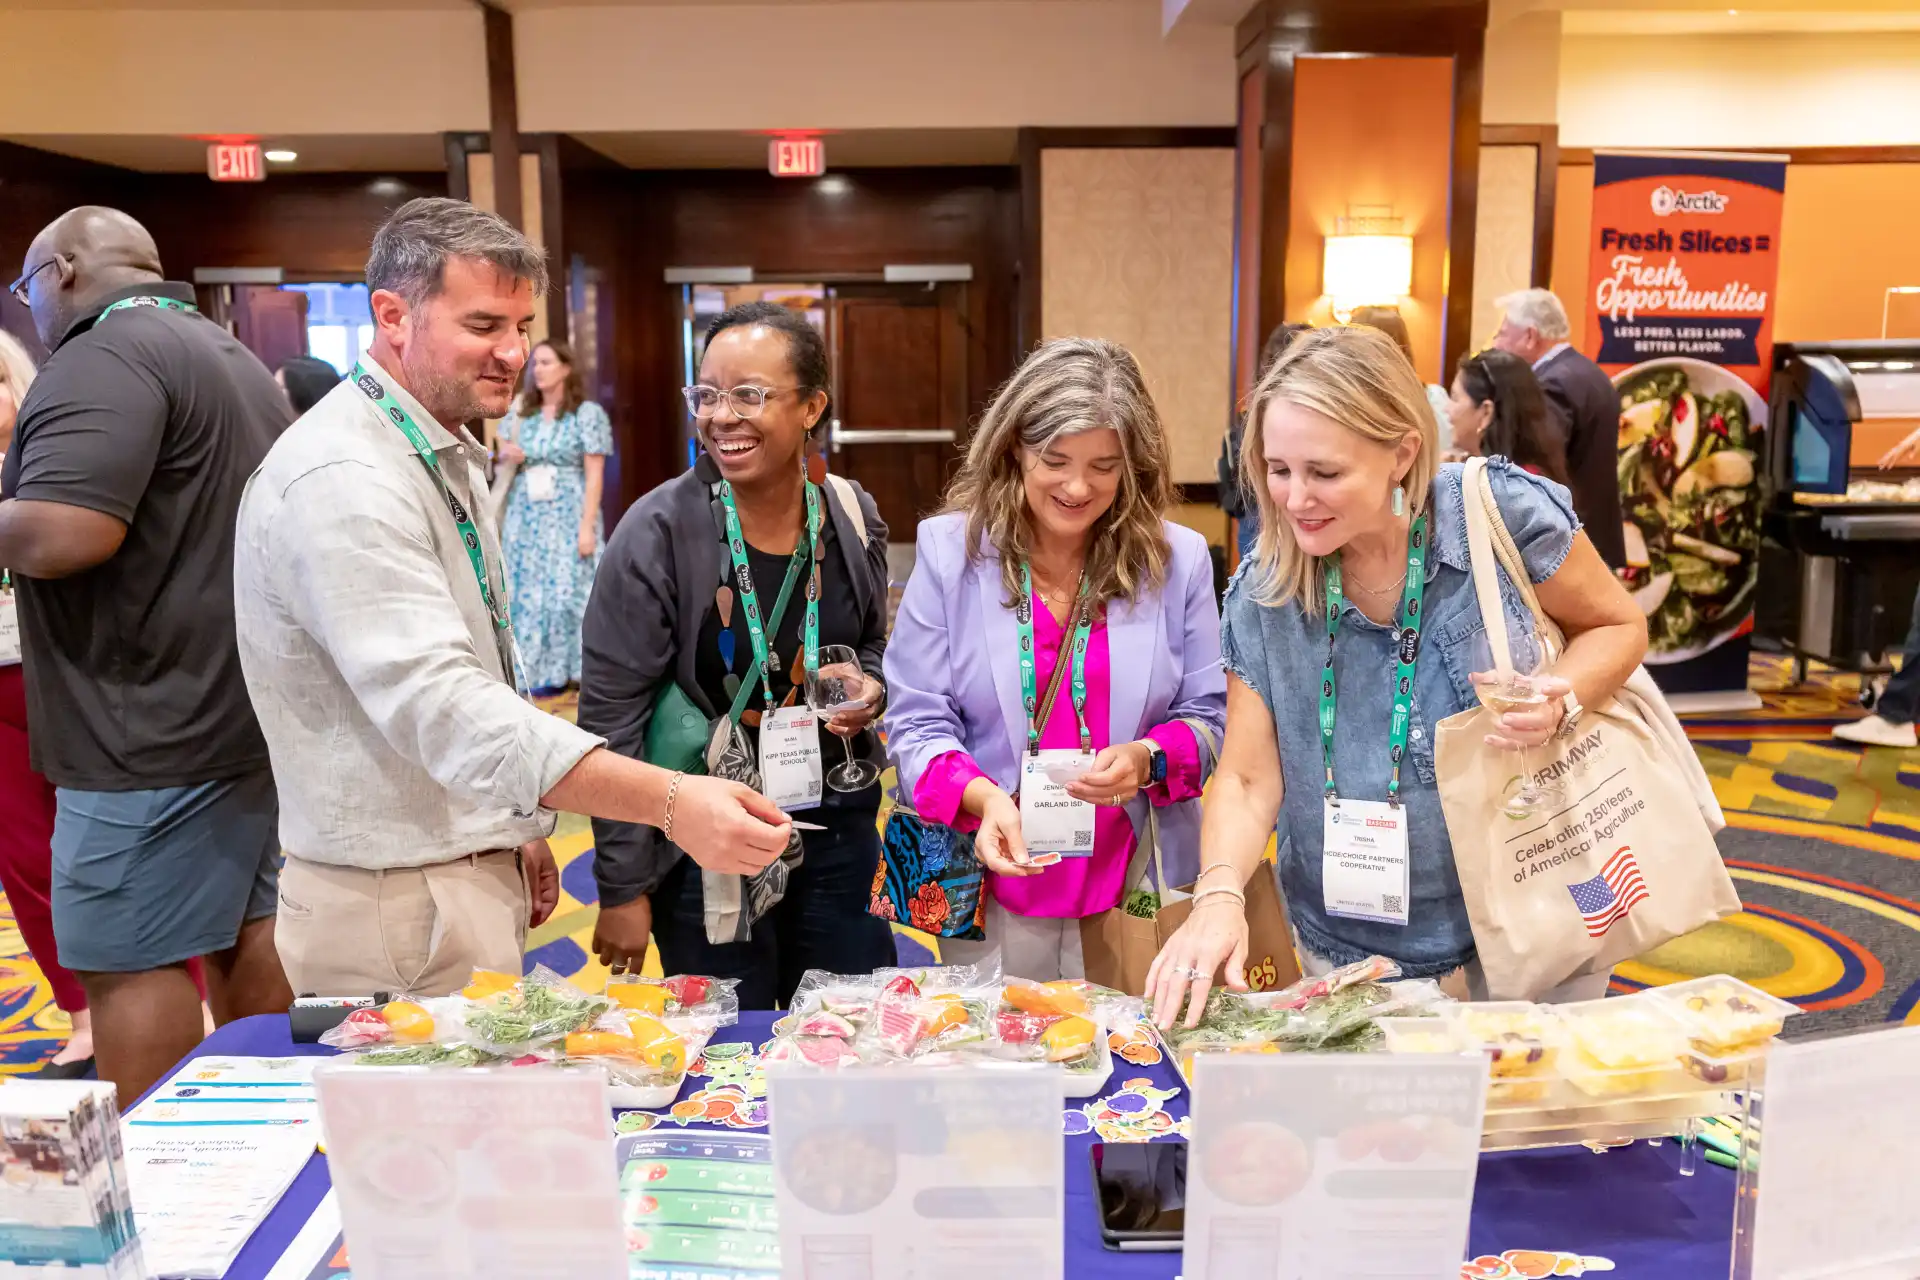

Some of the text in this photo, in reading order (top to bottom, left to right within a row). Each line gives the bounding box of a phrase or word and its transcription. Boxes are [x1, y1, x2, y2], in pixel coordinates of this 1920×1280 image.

[217, 145, 256, 178] EXIT
[778, 141, 816, 173] EXIT
[1674, 194, 1722, 211] Arctic
[1601, 228, 1672, 252] Fresh
[1679, 230, 1752, 254] Slices
[1611, 254, 1688, 290] Fresh
[1596, 278, 1767, 322] Opportunities
[1614, 327, 1746, 340] LESS PREP. LESS LABOR.
[1635, 341, 1724, 353] BETTER FLAVOR.
[741, 567, 752, 591] Taylor
[1022, 597, 1030, 622] Taylor
[1405, 632, 1418, 662] Taylor
[779, 758, 807, 766] SCHOOLS
[798, 748, 819, 756] PUBLIC
[1585, 803, 1607, 826] 250
[1605, 786, 1633, 811] Years
[1354, 835, 1375, 843] TRISHA
[1340, 861, 1386, 872] COOPERATIVE
[1368, 855, 1404, 864] PARTNERS
[1513, 867, 1527, 883] of
